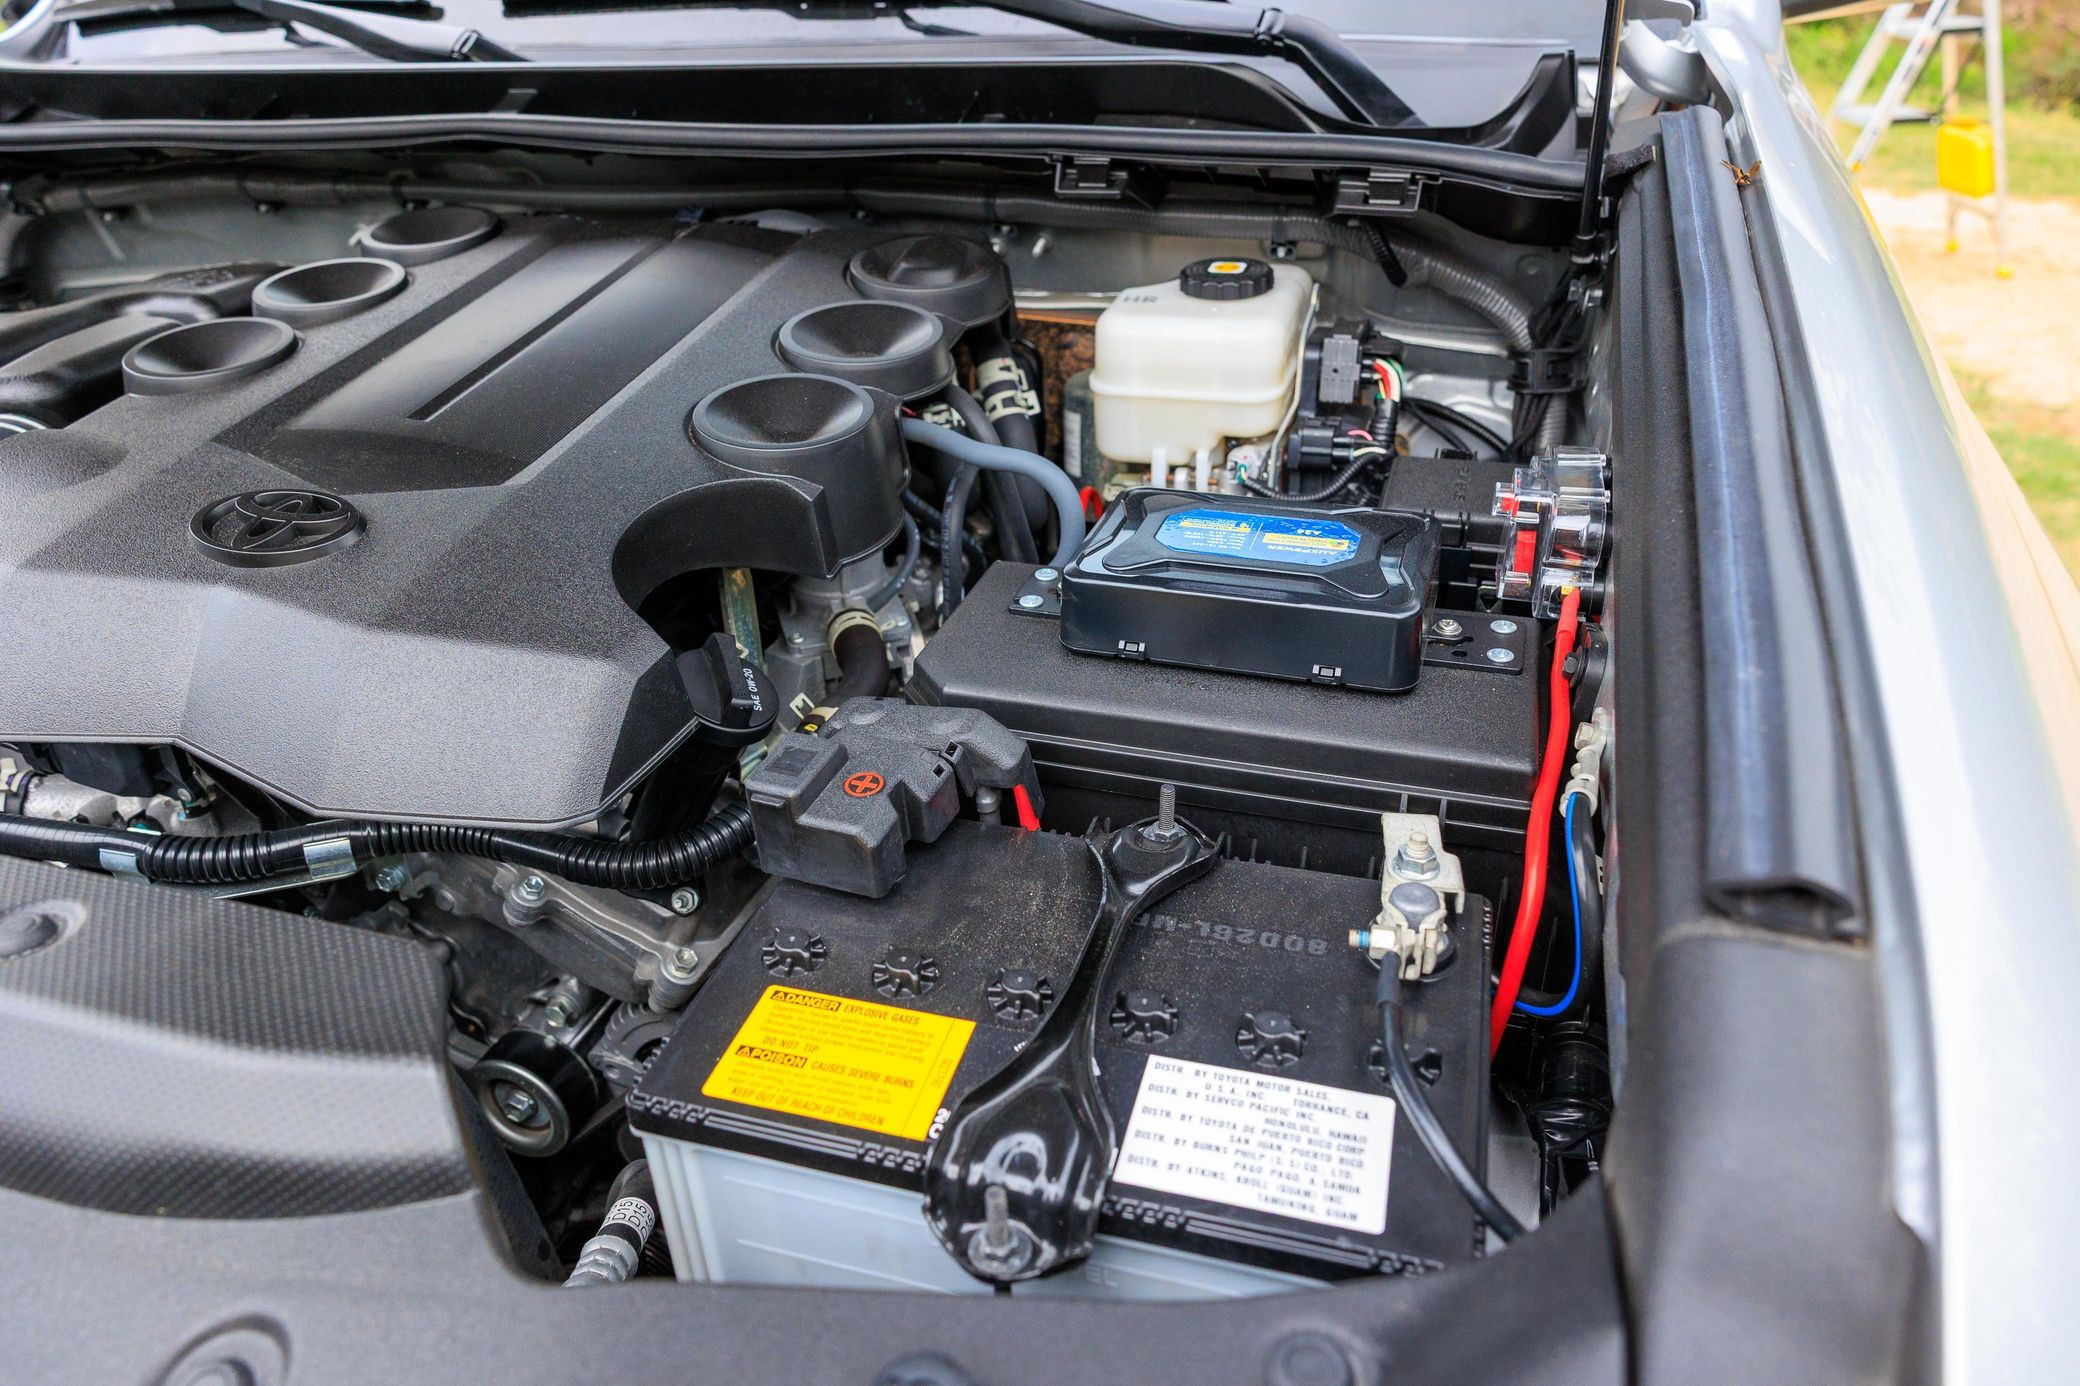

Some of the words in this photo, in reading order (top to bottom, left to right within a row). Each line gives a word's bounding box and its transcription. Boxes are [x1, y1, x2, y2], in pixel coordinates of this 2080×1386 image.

[1266, 544, 1338, 555] AUXPOWER
[743, 668, 758, 692] 0W-20
[751, 694, 762, 711] SAE
[783, 992, 841, 1011] DANGER
[842, 1003, 889, 1020] EXPLOSIVE
[889, 1012, 921, 1026] GASES
[761, 1035, 778, 1046] DO
[777, 1038, 799, 1050] NOT
[802, 1043, 820, 1054] TIP
[748, 1047, 807, 1067] POISON
[809, 1059, 847, 1075] CAUSES
[846, 1067, 882, 1082] SEVERE
[882, 1074, 917, 1089] BURNS
[1193, 1068, 1207, 1078] BY
[1212, 1071, 1250, 1085] TOYOTA
[1255, 1079, 1290, 1092] MOTOR
[1295, 1087, 1331, 1101] SALES,
[730, 1086, 753, 1098] KEEP
[754, 1091, 775, 1102] OUT
[774, 1095, 789, 1105] OF
[788, 1098, 822, 1112] REACH
[821, 1105, 835, 1115] OF
[835, 1108, 885, 1126] CHILDREN
[1185, 1090, 1198, 1099] BY
[1204, 1093, 1244, 1107] SERVCO
[1249, 1101, 1289, 1116] PACIFIC
[1292, 1098, 1350, 1116] TORRANCE,
[1355, 1109, 1369, 1120] CA
[1173, 1136, 1186, 1146] BY
[1179, 1112, 1192, 1122] BY
[1198, 1116, 1238, 1130] TOYOTA
[1242, 1124, 1255, 1133] DE
[1261, 1128, 1301, 1142] PUERTO
[1307, 1137, 1332, 1149] RICO
[1328, 1129, 1367, 1143] HAWAII
[1229, 1134, 1250, 1145] SAN
[1290, 1146, 1332, 1162] PUERTO
[1338, 1155, 1364, 1168] RICO
[1166, 1161, 1180, 1172] BY
[612, 1201, 633, 1220] D15
[628, 1203, 647, 1228] D15
